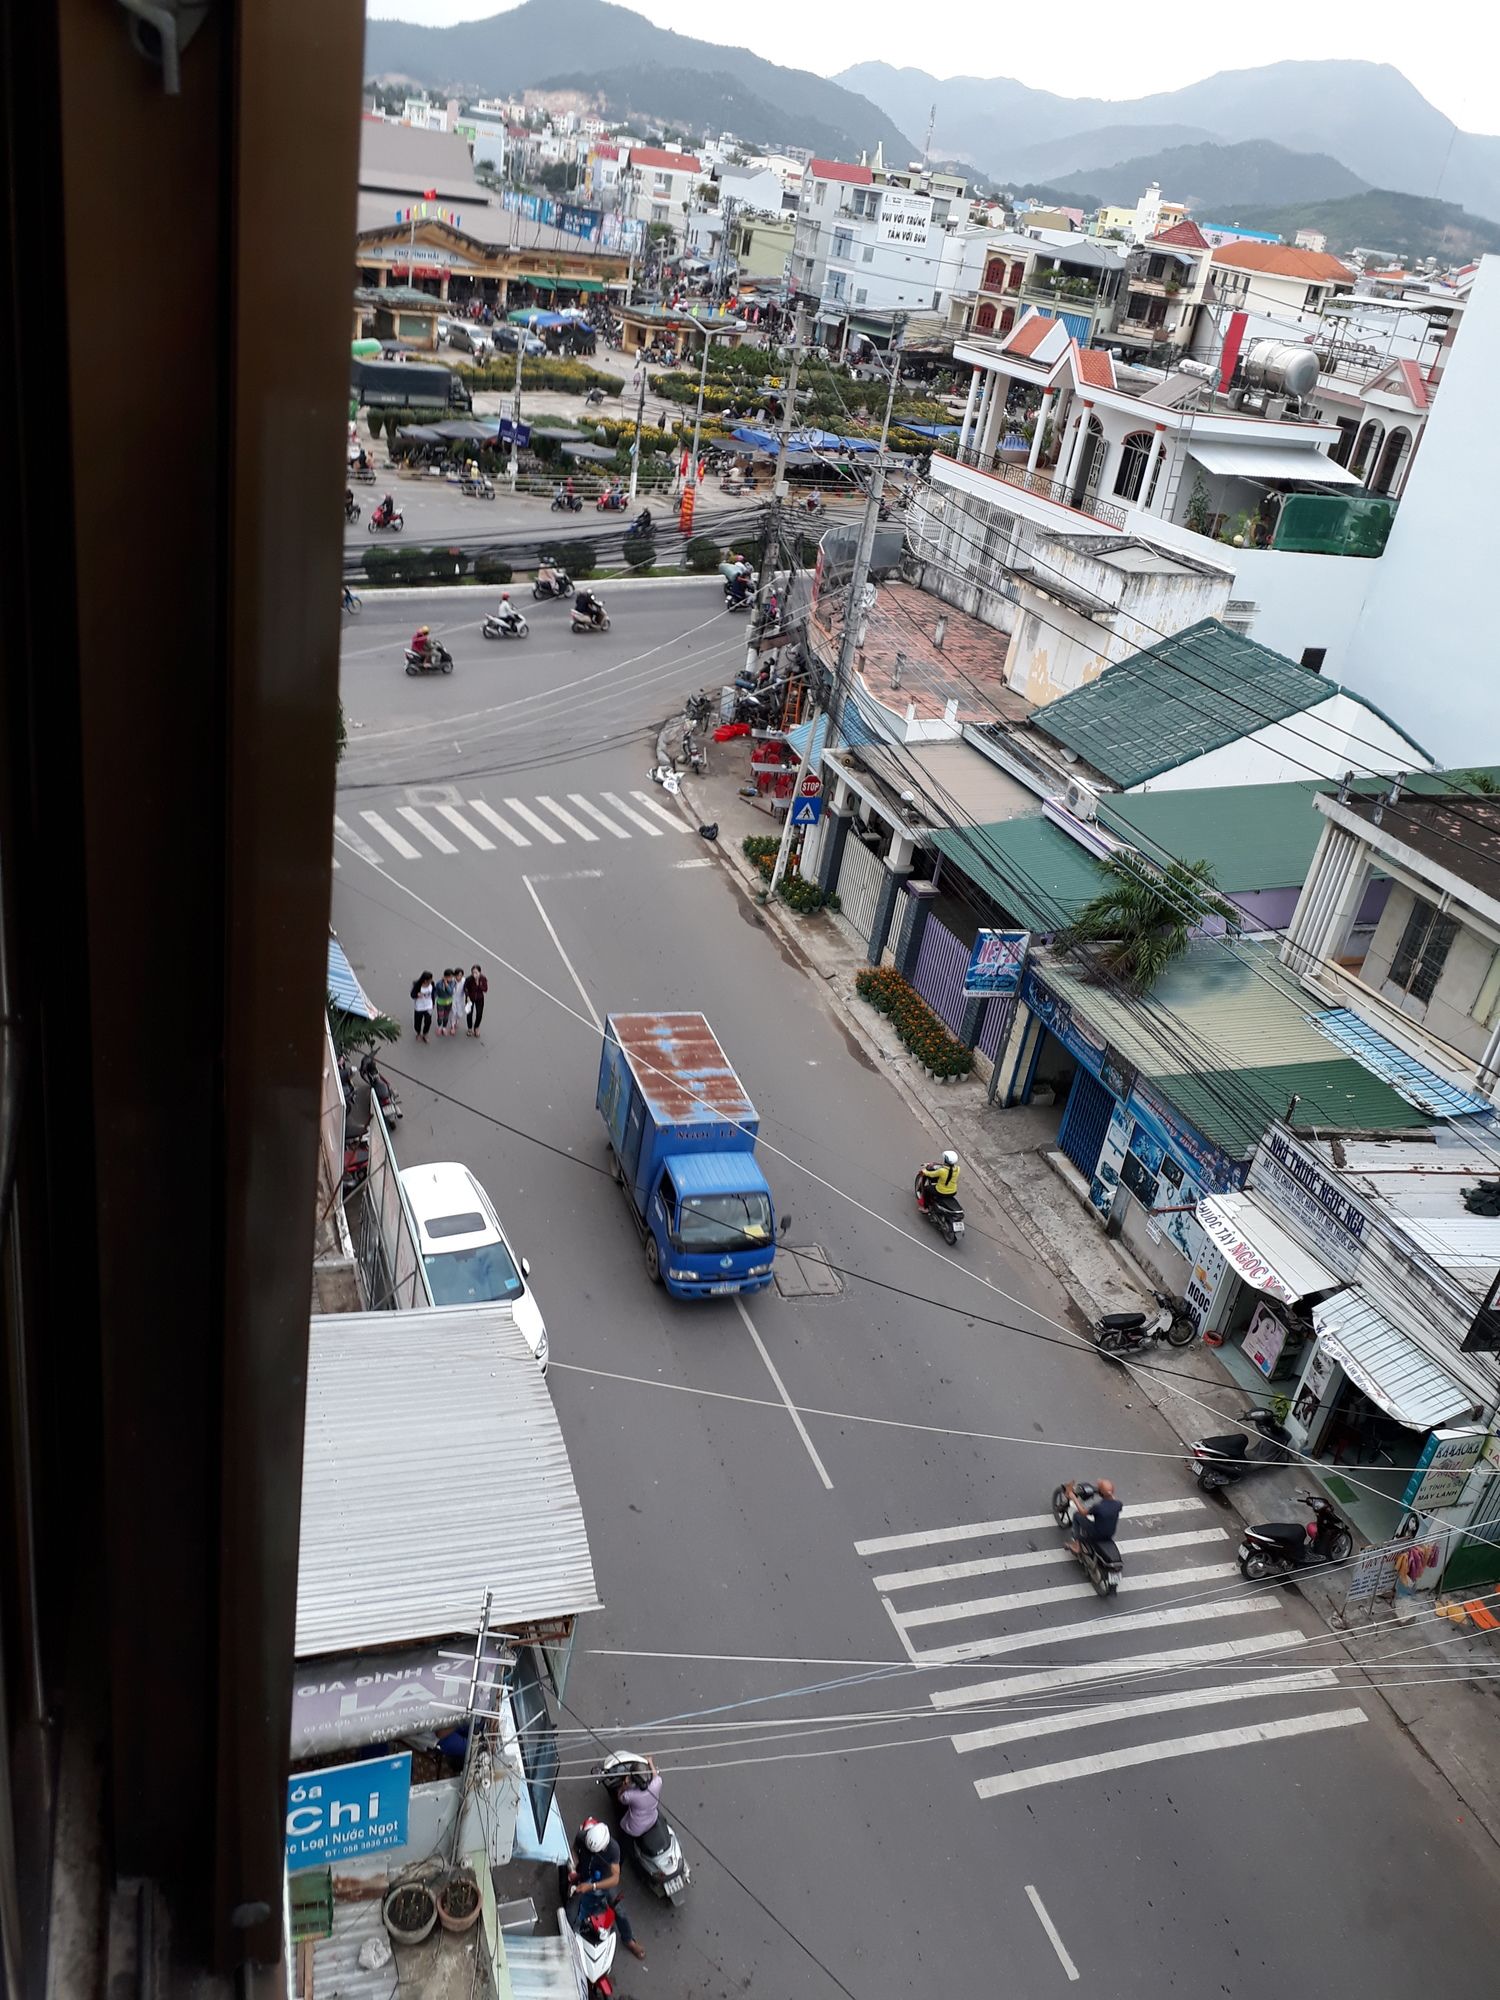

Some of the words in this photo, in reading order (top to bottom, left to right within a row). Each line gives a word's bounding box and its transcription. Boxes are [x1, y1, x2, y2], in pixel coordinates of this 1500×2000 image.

[802, 782, 819, 792] STOP
[1345, 1205, 1366, 1239] NGA
[297, 1680, 346, 1697] GIA
[355, 1666, 423, 1688] ĐÌNH
[286, 1792, 379, 1837] Chi
[301, 1834, 329, 1852] Loại
[332, 1828, 364, 1845] Nước
[369, 1820, 398, 1837] Ngọt
